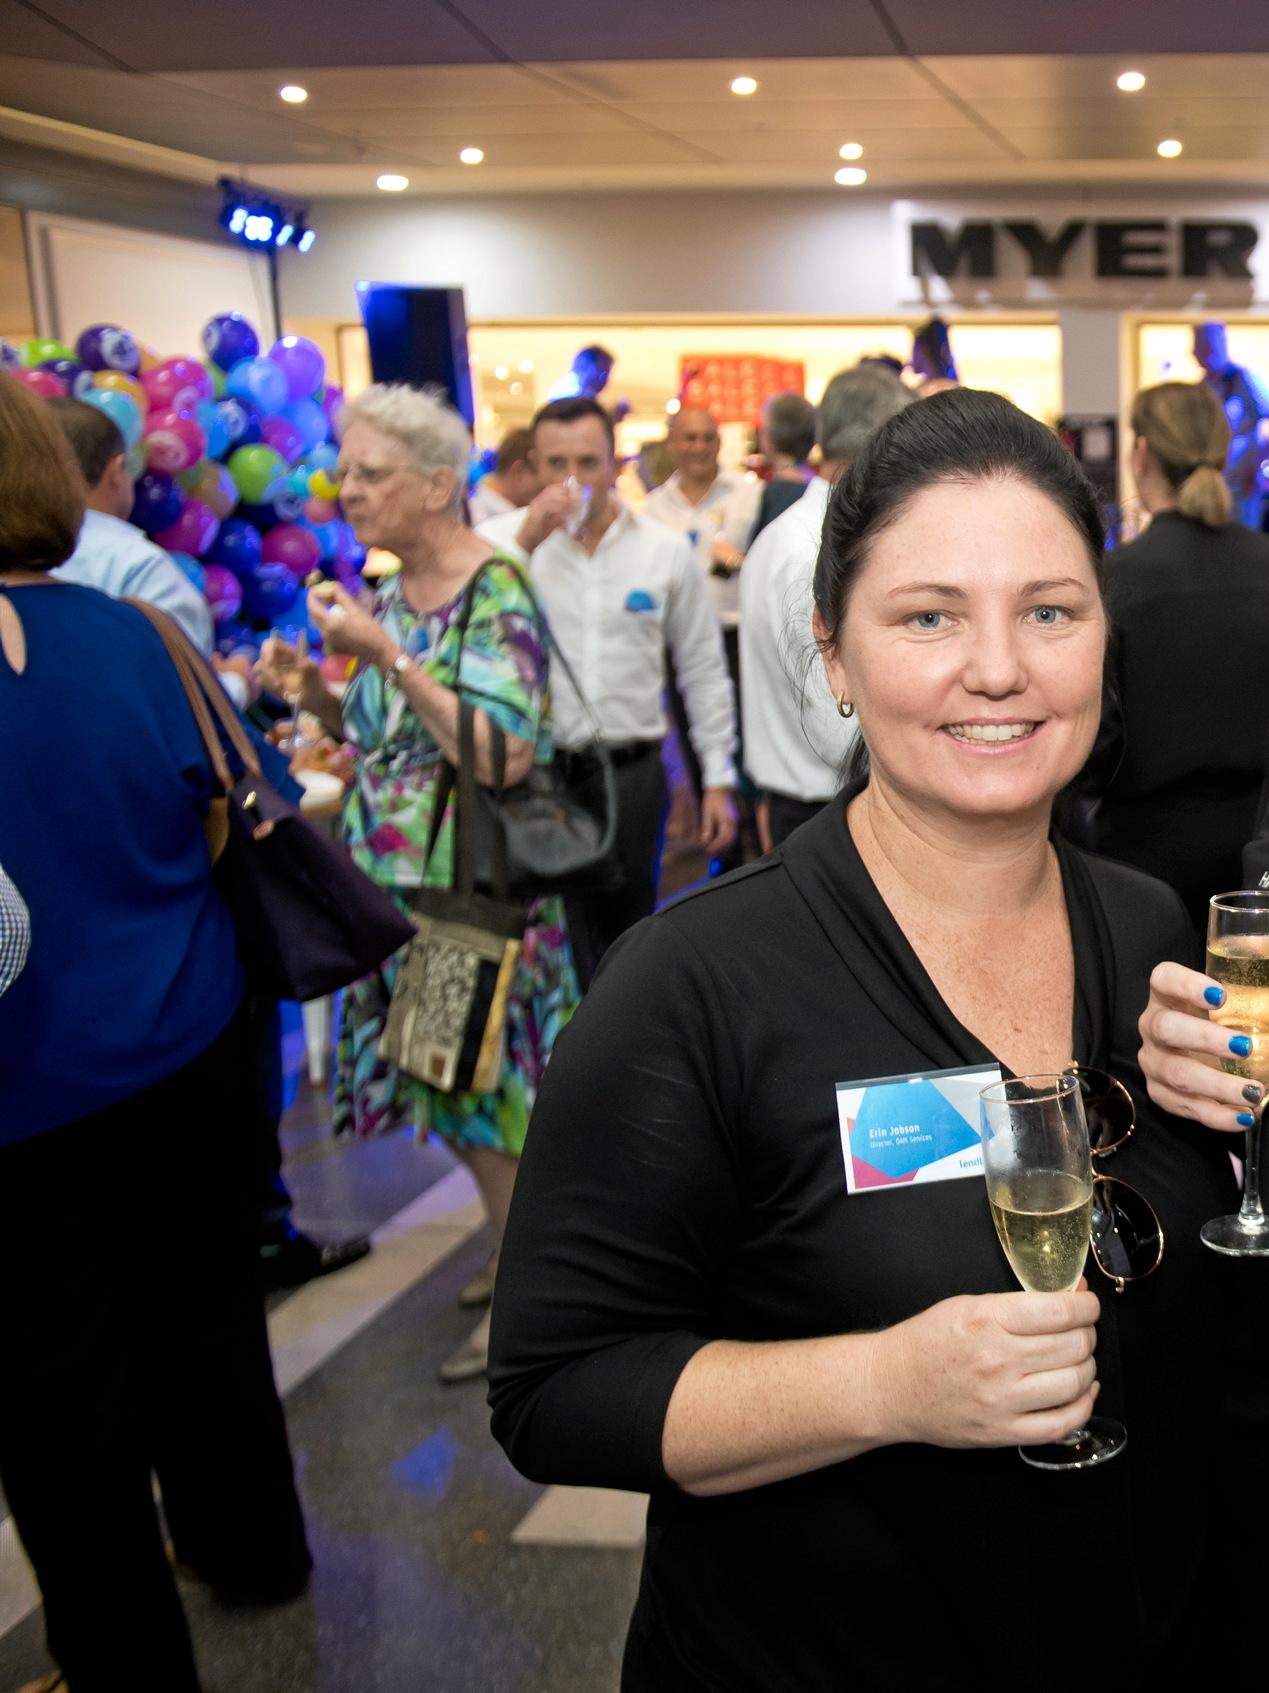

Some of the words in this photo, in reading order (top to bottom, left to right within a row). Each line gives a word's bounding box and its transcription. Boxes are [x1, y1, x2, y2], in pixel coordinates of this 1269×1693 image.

[910, 218, 1258, 277] MYER
[869, 1127, 887, 1138] Erin
[959, 1158, 983, 1169] lendl
